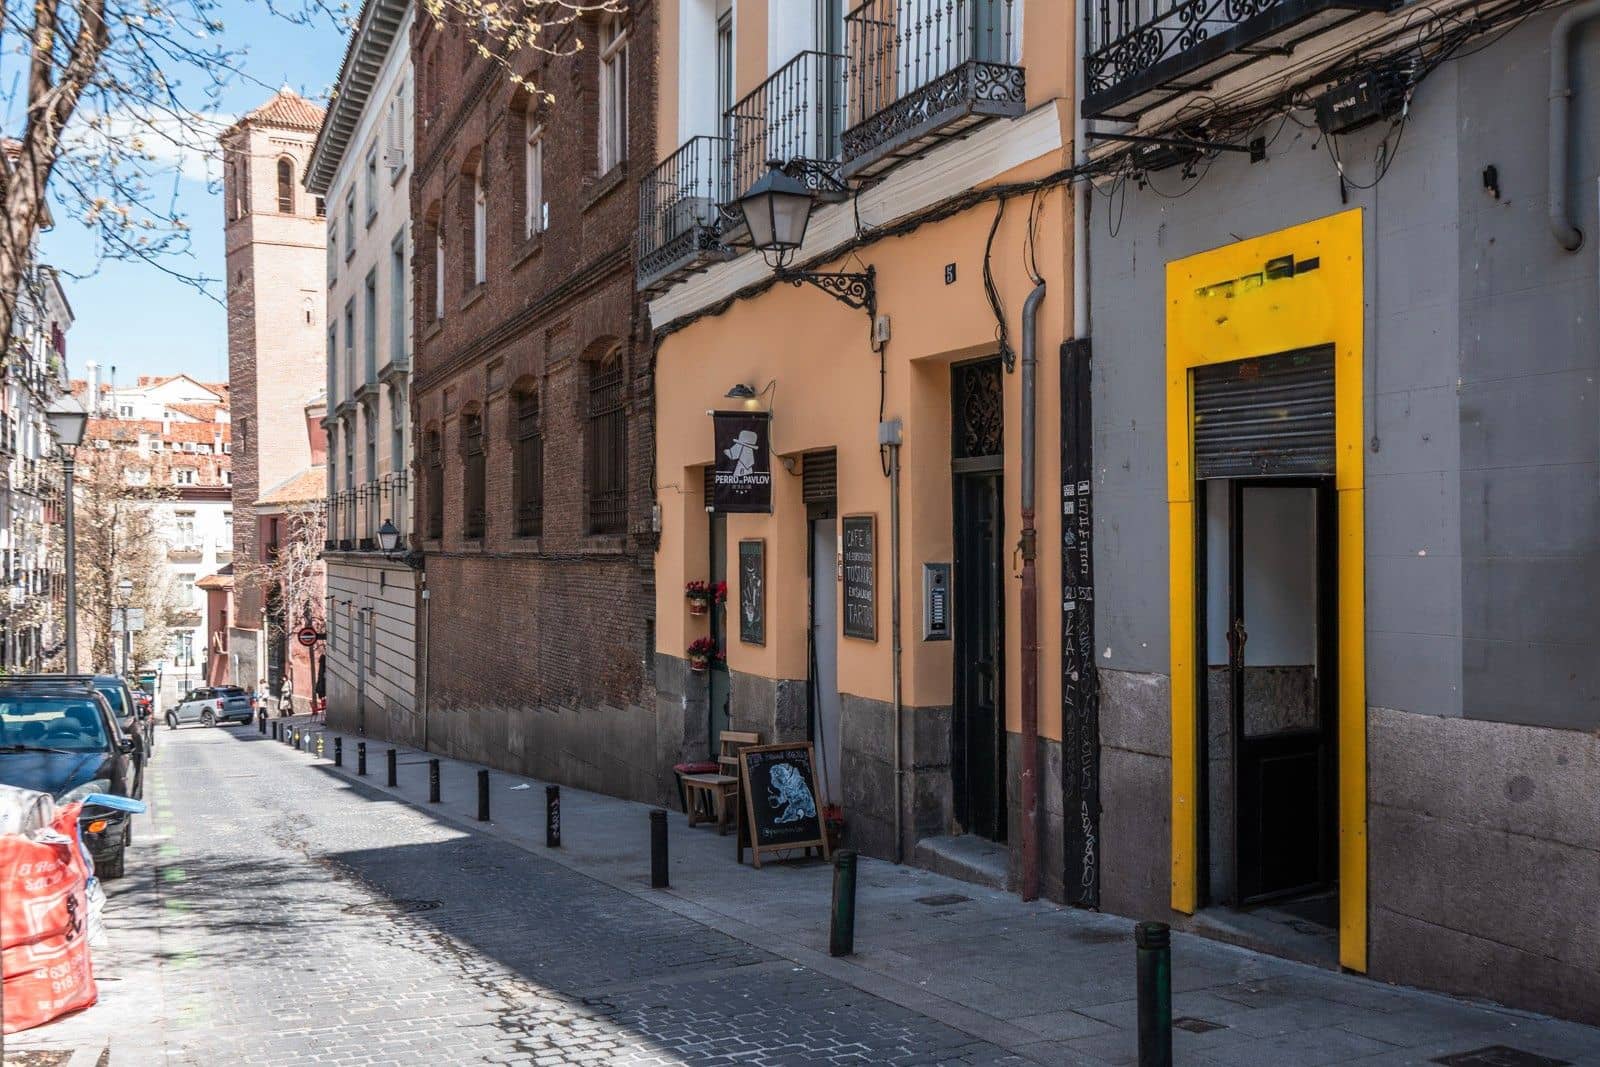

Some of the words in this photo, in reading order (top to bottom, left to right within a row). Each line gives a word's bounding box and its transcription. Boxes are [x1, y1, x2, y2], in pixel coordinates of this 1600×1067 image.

[946, 265, 953, 283] 5
[715, 475, 738, 484] PERRO
[743, 475, 770, 485] PAVLOV
